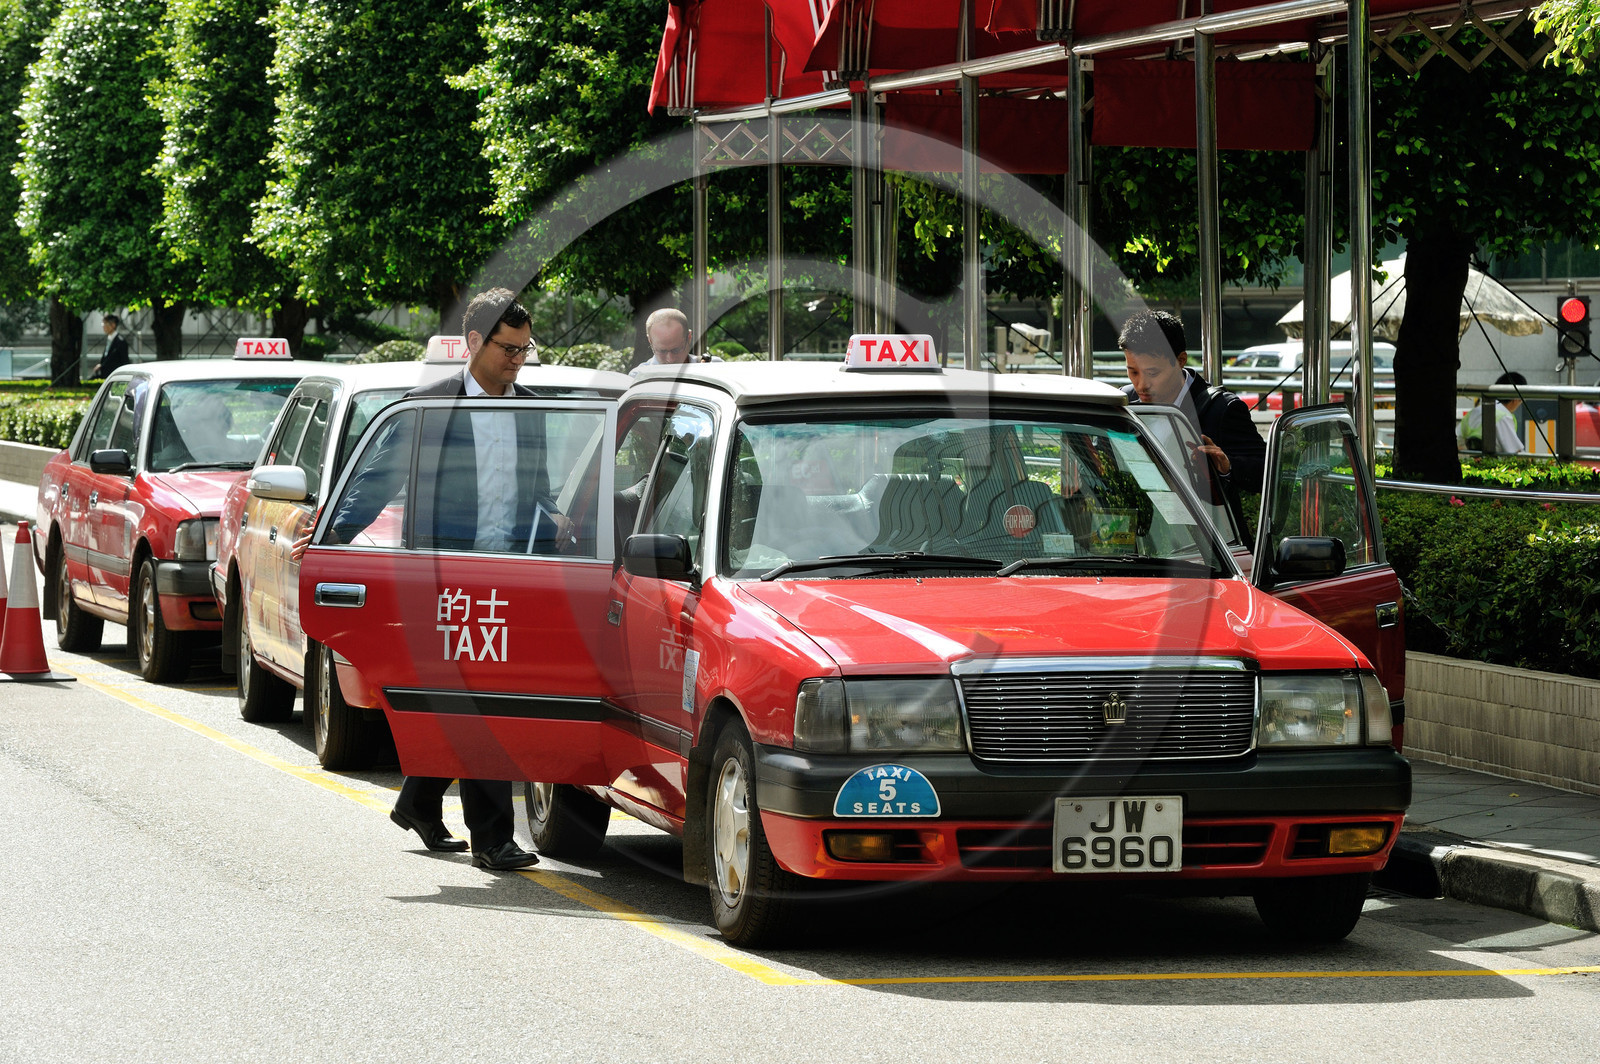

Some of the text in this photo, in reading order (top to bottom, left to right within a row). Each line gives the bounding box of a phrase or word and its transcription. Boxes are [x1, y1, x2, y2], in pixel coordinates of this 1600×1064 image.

[243, 342, 286, 355] TAXI
[859, 339, 930, 362] TAXI
[1005, 514, 1034, 529] FOR HIRE
[437, 587, 509, 624] 的士
[436, 624, 508, 662] TAXI
[863, 766, 912, 782] TAXI
[878, 778, 897, 801] 5
[853, 802, 921, 814] SEATS
[1090, 801, 1146, 833] JW
[1062, 835, 1174, 869] 6960
